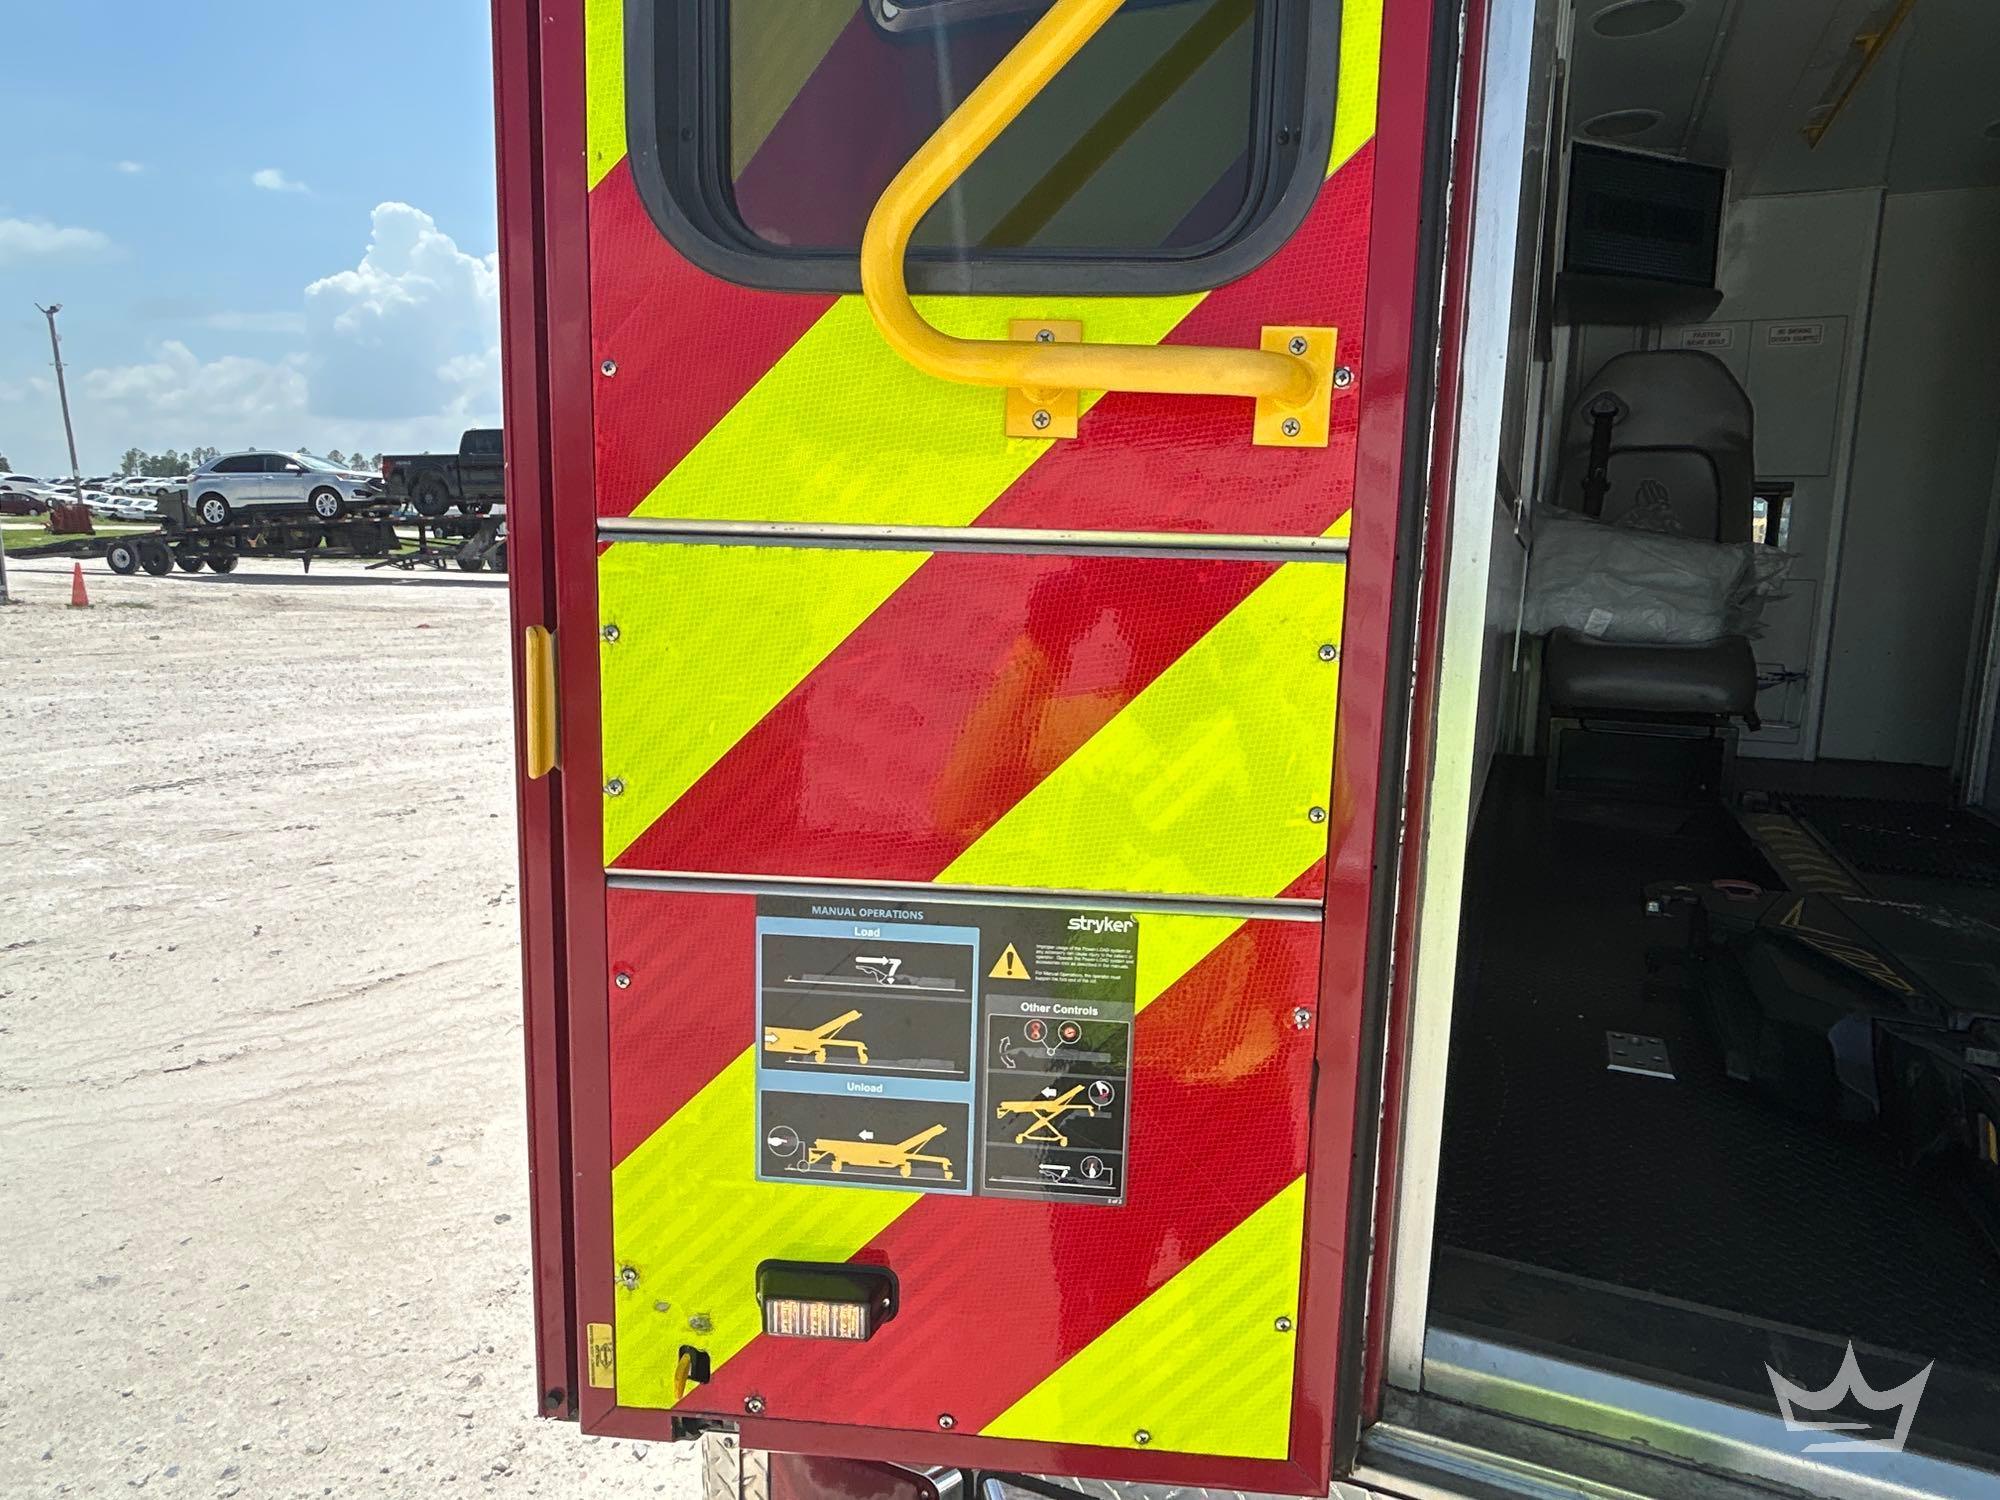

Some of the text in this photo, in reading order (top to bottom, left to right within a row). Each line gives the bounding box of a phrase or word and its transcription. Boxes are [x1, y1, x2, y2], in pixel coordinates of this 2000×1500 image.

[811, 905, 924, 920] MANUAL OPERATIONS
[854, 926, 881, 937] Load
[1067, 915, 1134, 934] stryker
[1020, 1002, 1099, 1016] Other Controls
[847, 1081, 883, 1093] Unload
